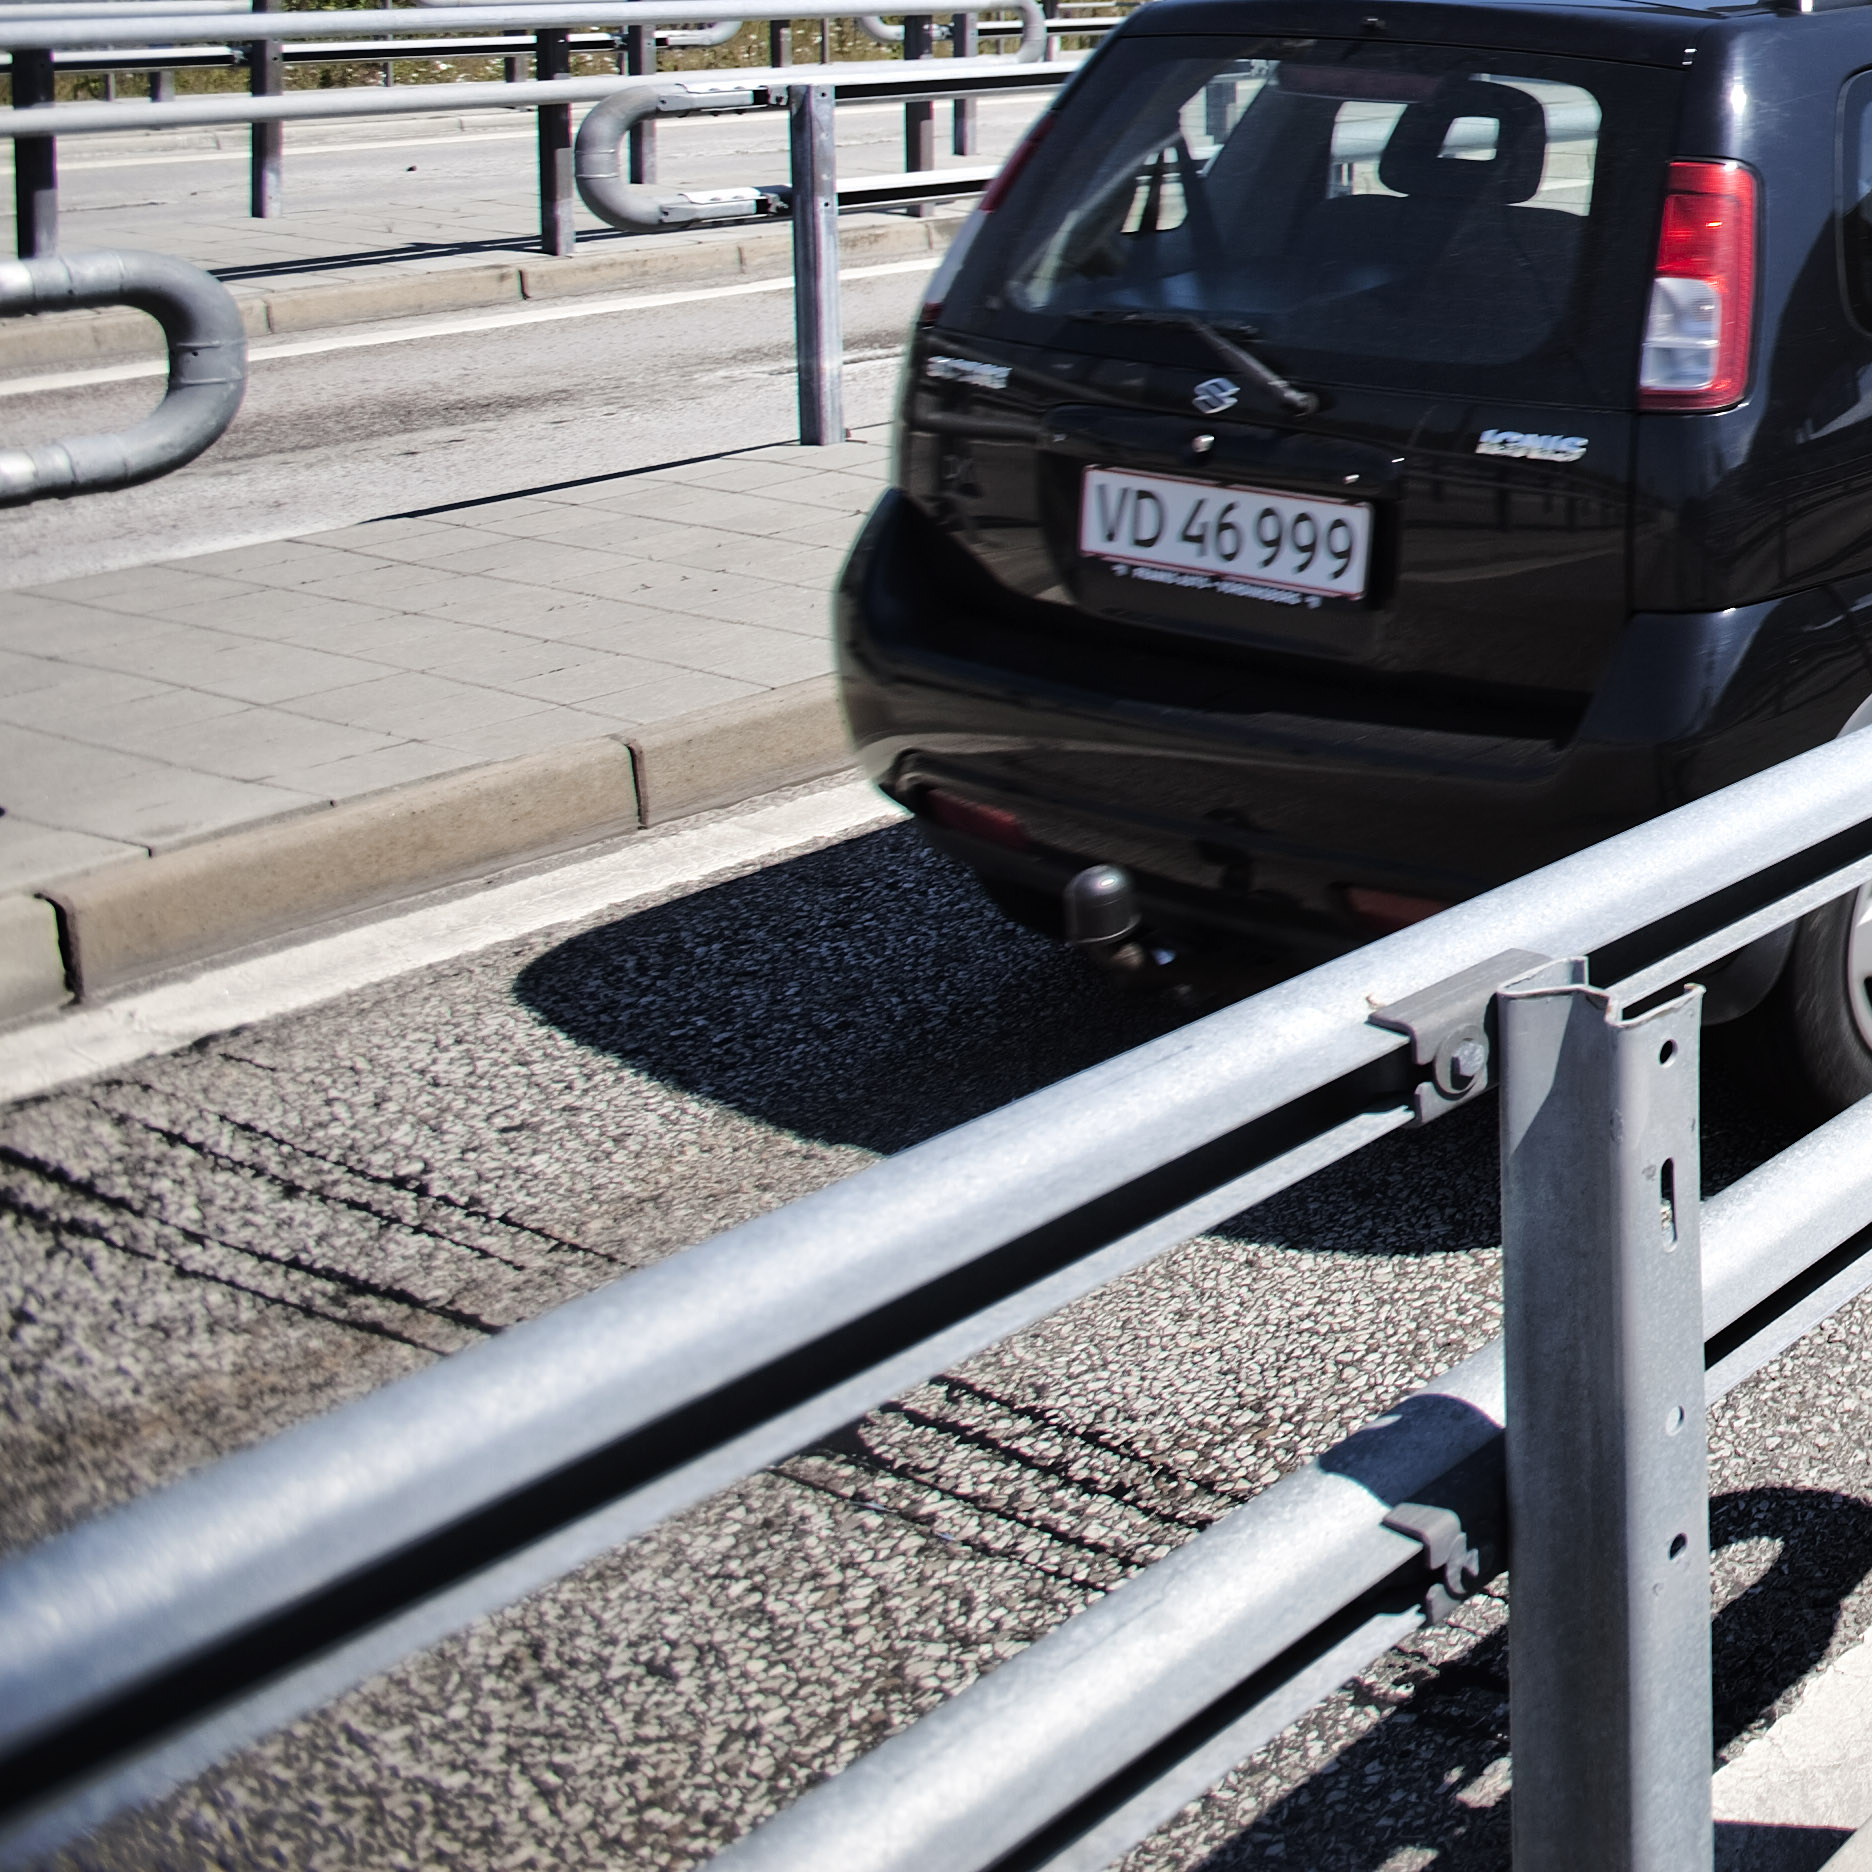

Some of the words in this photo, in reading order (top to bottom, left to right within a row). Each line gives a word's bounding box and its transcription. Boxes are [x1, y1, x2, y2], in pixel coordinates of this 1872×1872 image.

[1096, 483, 1168, 548] VD
[1177, 498, 1244, 562] 46
[1257, 507, 1356, 581] 999
